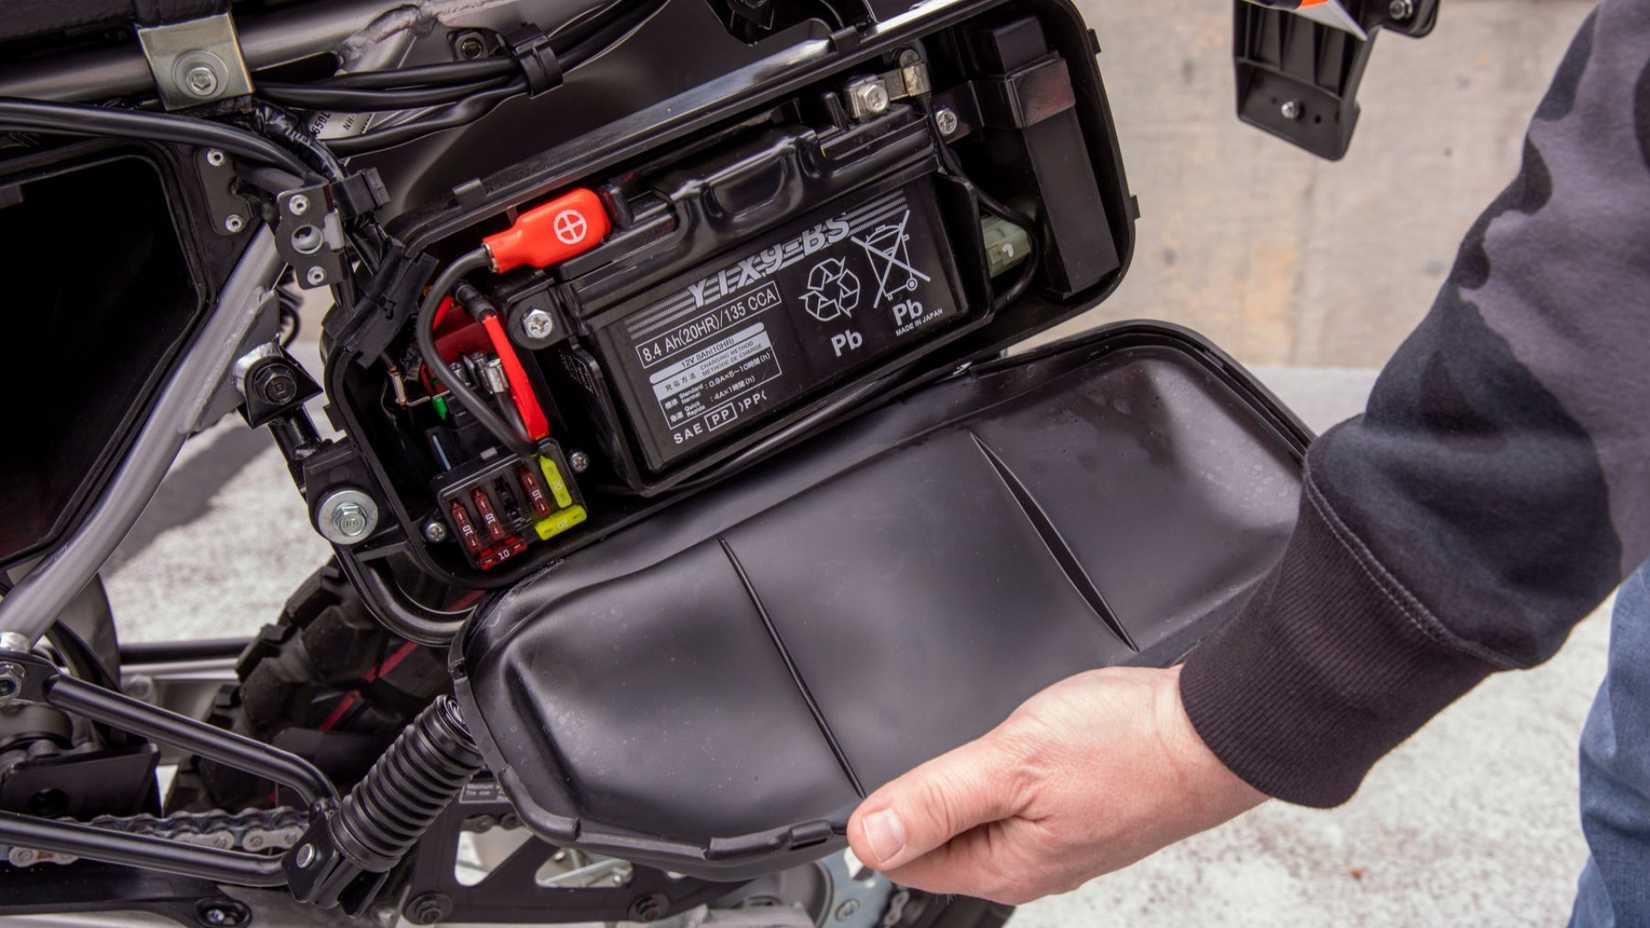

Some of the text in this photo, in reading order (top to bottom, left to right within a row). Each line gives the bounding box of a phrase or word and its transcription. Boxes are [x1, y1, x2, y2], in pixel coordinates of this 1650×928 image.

[642, 288, 777, 362] 8.4 Ah(20HR)/135 CCA
[892, 299, 923, 327] Pb
[895, 322, 914, 336] MADE
[922, 308, 944, 324] JAPAN
[831, 329, 863, 357] Pb
[674, 423, 703, 444] SAE
[711, 409, 730, 425] PP
[498, 549, 511, 560] 10
